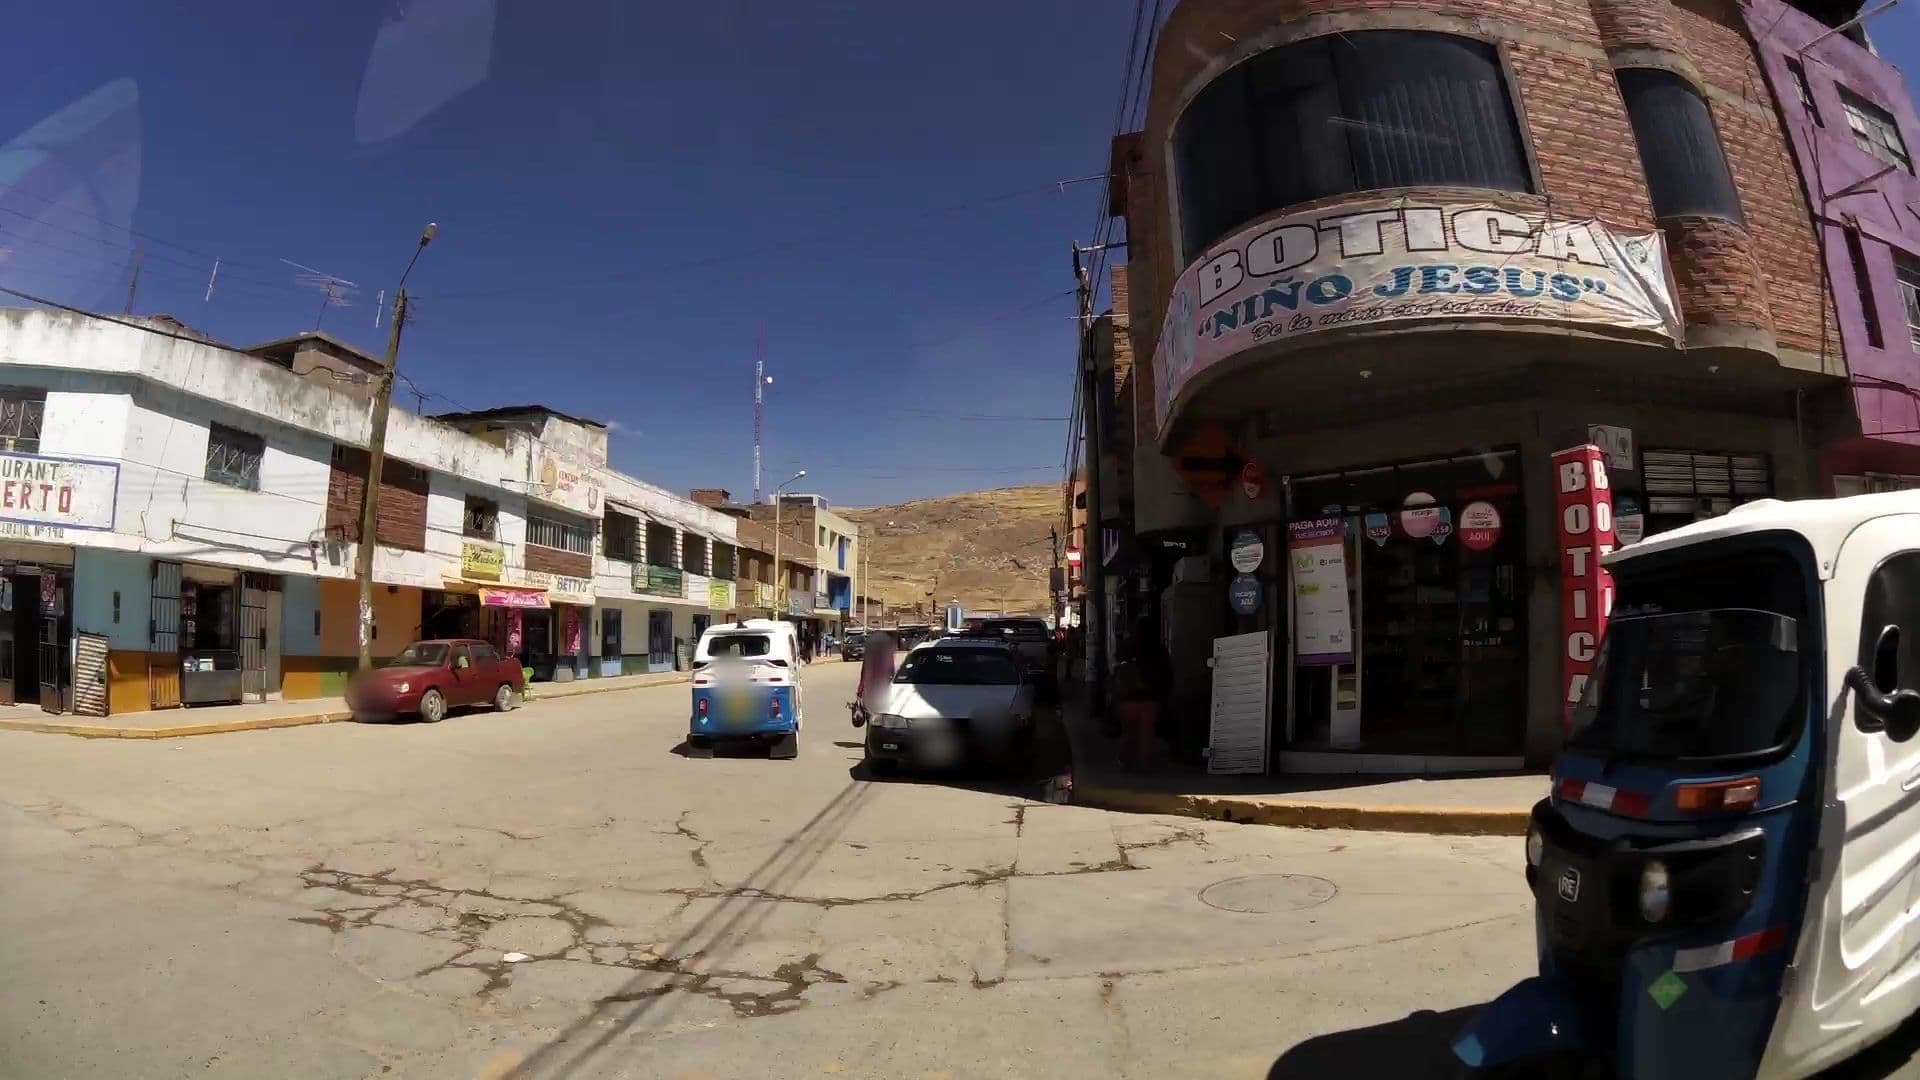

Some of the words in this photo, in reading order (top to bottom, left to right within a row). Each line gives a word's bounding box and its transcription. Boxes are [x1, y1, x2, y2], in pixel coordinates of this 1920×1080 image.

[1197, 206, 1610, 309] BOTICA
[3, 480, 72, 513] ERTO
[1289, 520, 1314, 531] PAGA
